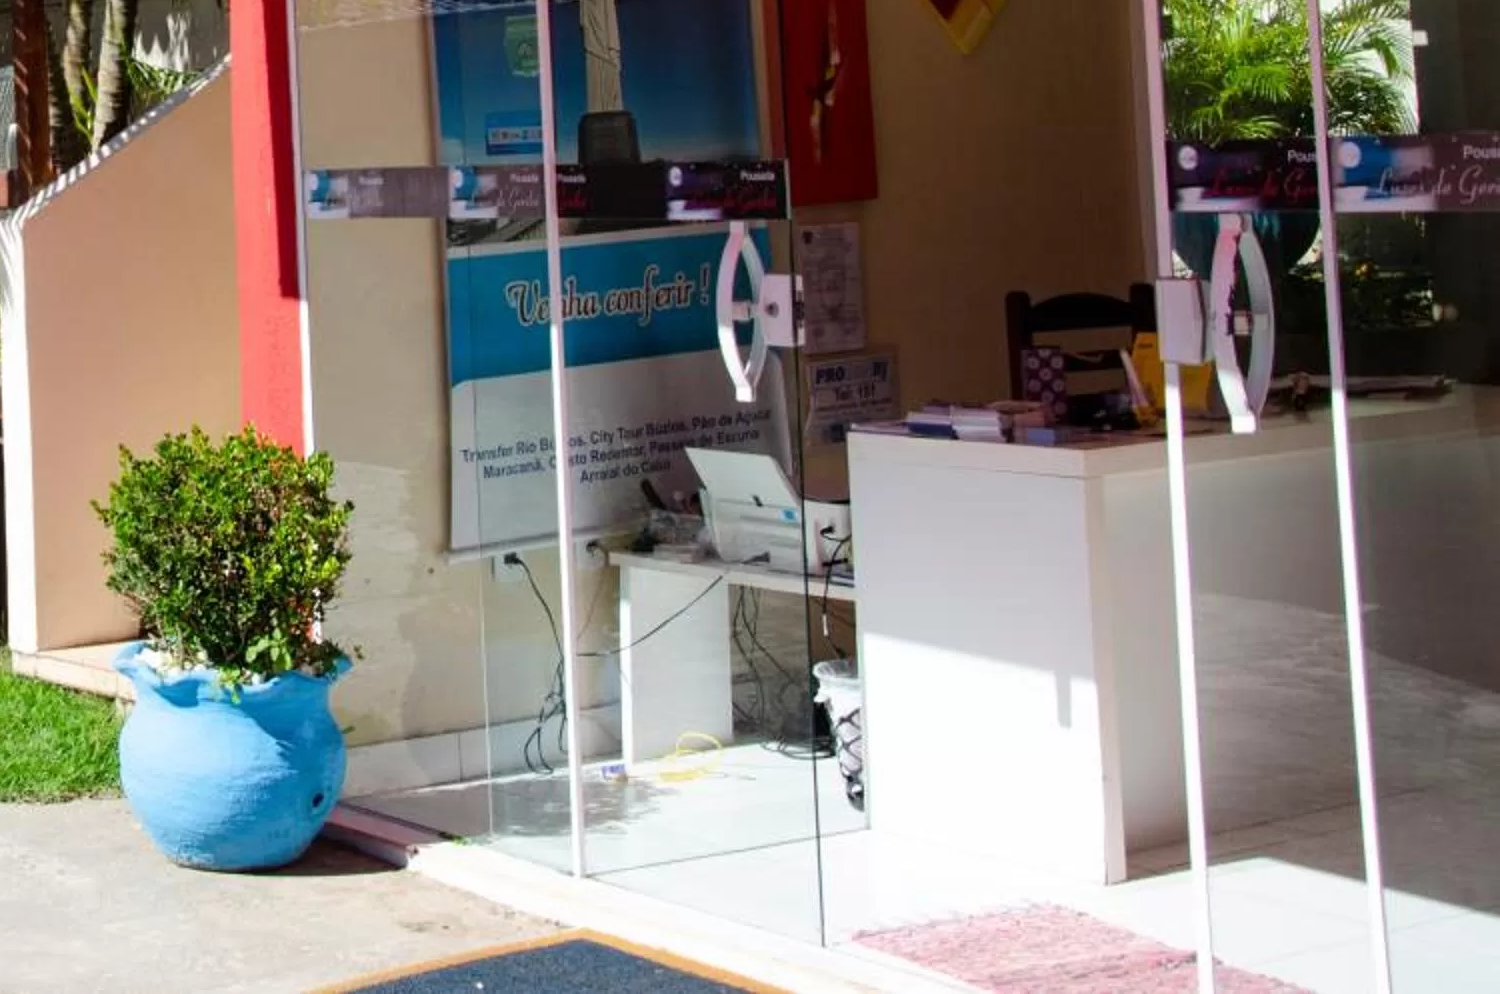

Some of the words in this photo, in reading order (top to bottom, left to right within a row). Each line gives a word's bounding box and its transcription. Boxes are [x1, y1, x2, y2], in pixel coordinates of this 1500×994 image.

[604, 263, 695, 326] conferir
[460, 444, 513, 463] Transfer
[516, 440, 537, 455] Rio
[589, 430, 615, 446] City
[616, 425, 644, 440] Tour
[623, 462, 640, 477] do
